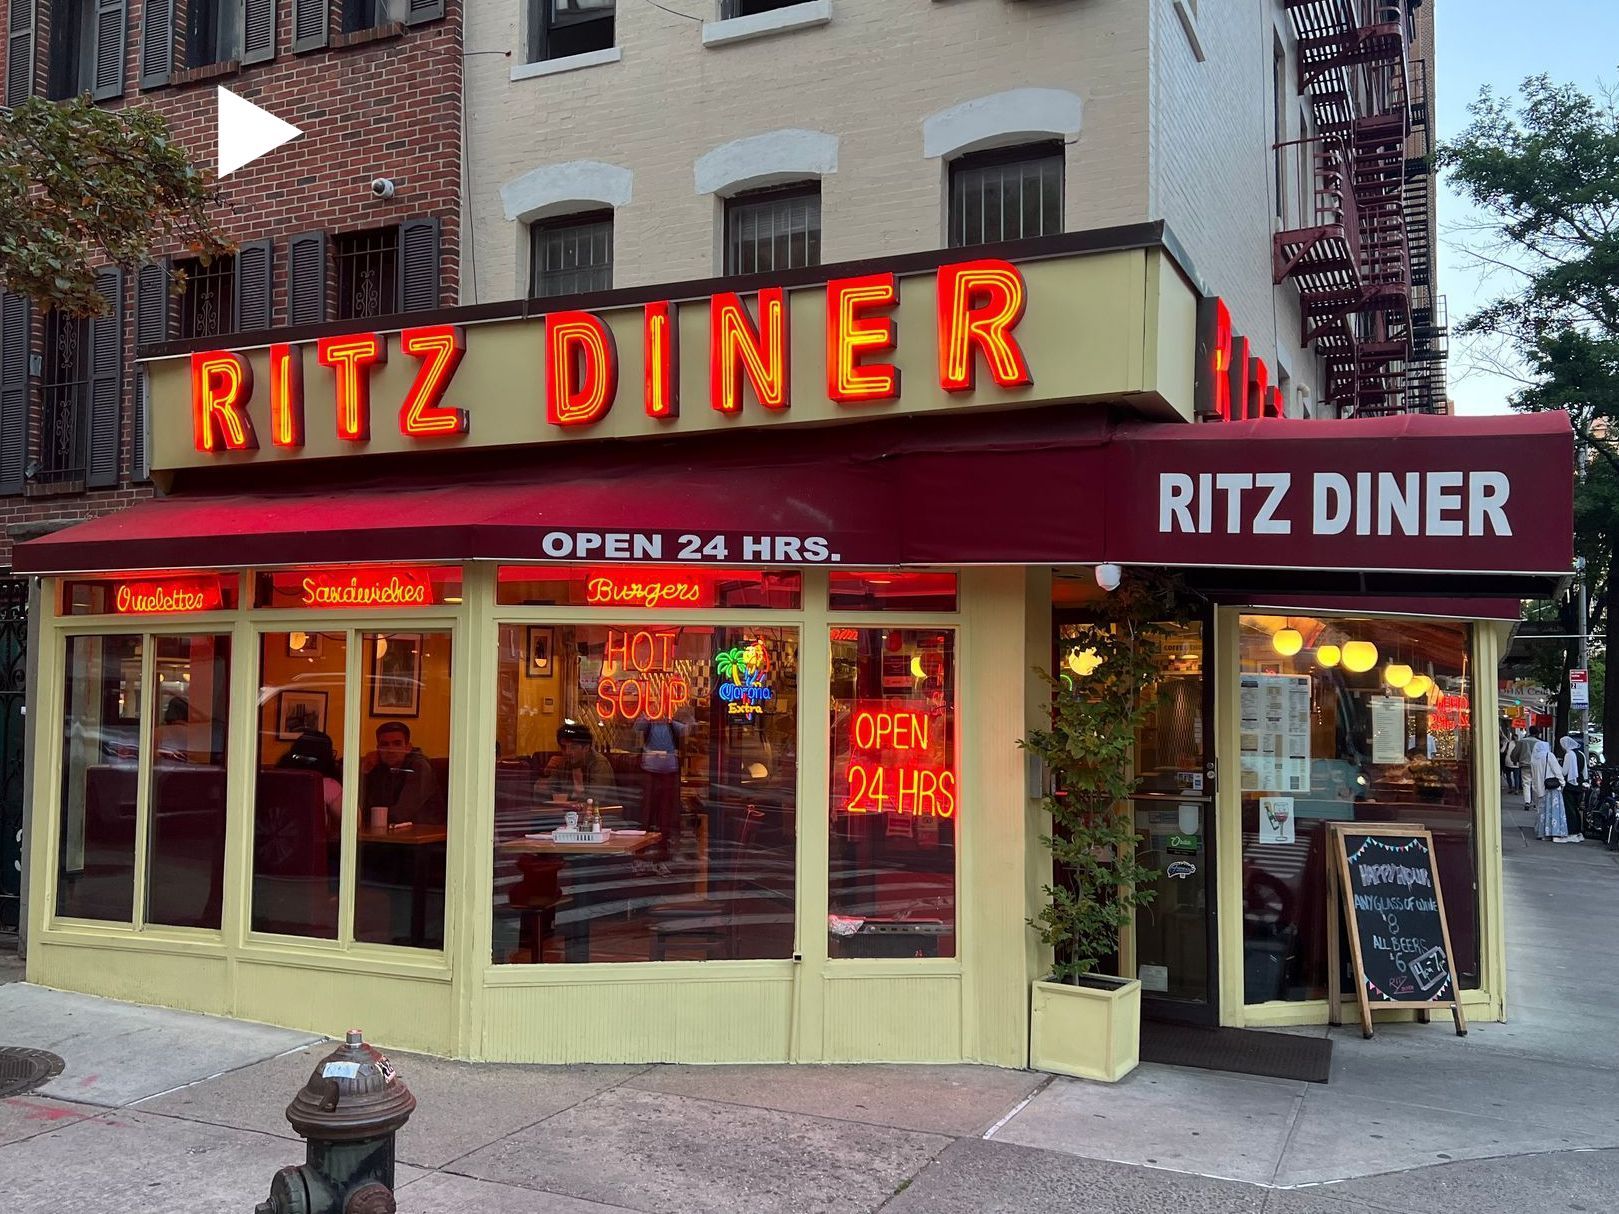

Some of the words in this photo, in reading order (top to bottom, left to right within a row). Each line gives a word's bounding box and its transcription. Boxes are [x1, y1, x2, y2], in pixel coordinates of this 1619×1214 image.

[191, 325, 468, 453] RITZ
[545, 259, 1033, 426] DINER
[1159, 472, 1291, 534] RITZ
[1312, 471, 1513, 537] DINER
[542, 532, 662, 559] OPEN
[677, 534, 728, 560] 24
[743, 536, 841, 562] HRS.
[302, 576, 425, 604] Sandwiches
[587, 578, 700, 607] Burgers
[608, 631, 676, 673] HOT
[596, 679, 688, 721] SOUP
[719, 682, 772, 702] Corona
[728, 702, 763, 714] Extra
[855, 712, 930, 750] OPEN
[847, 765, 889, 813] 24
[897, 768, 955, 818] HRS
[1354, 894, 1374, 911] ANY
[1403, 896, 1415, 912] OF
[1373, 935, 1391, 950] ALL
